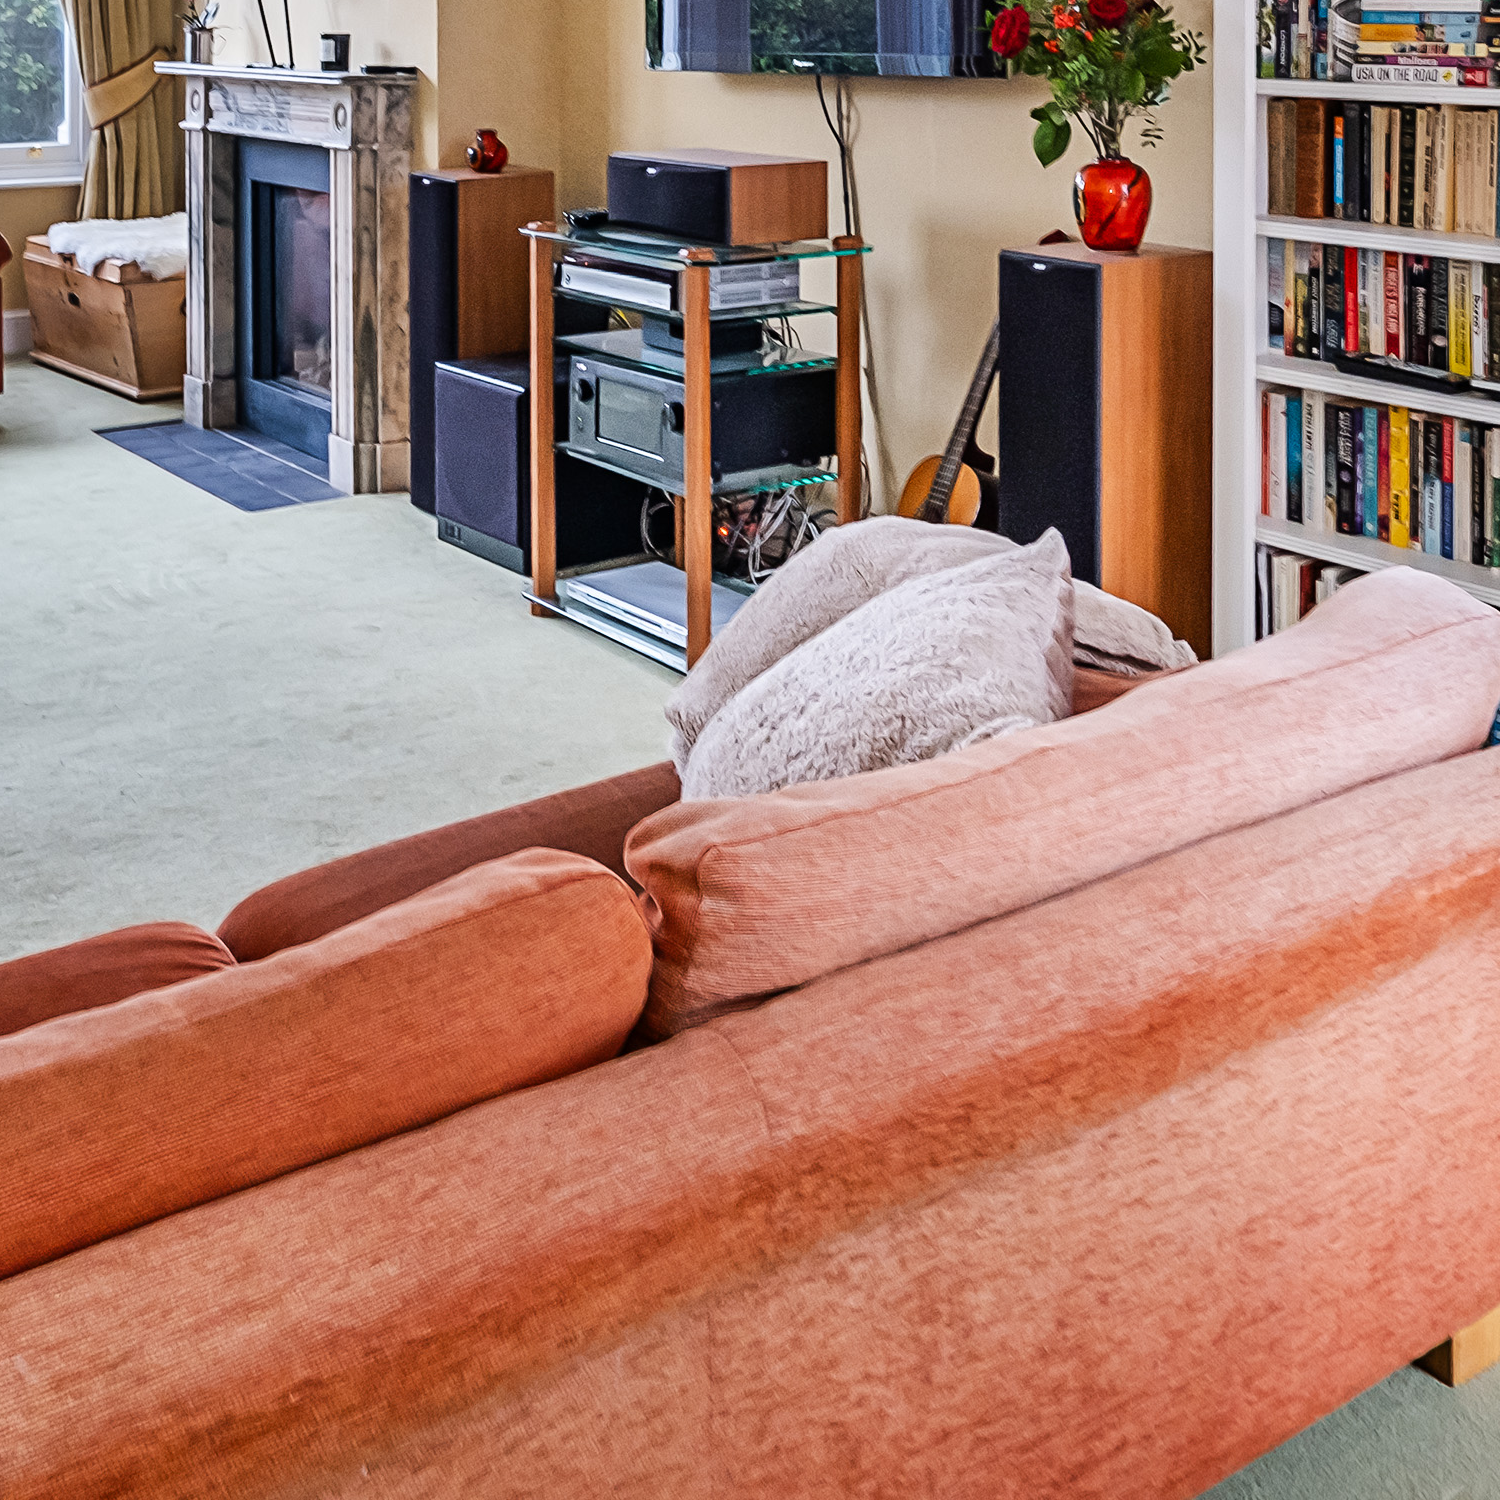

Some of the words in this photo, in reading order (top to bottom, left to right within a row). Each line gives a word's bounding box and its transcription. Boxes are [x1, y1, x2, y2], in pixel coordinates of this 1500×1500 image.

[1279, 29, 1288, 65] LONDON
[1355, 66, 1375, 82] USA
[1376, 67, 1390, 81] ON
[1392, 68, 1410, 82] THE
[1411, 68, 1439, 83] ROAD
